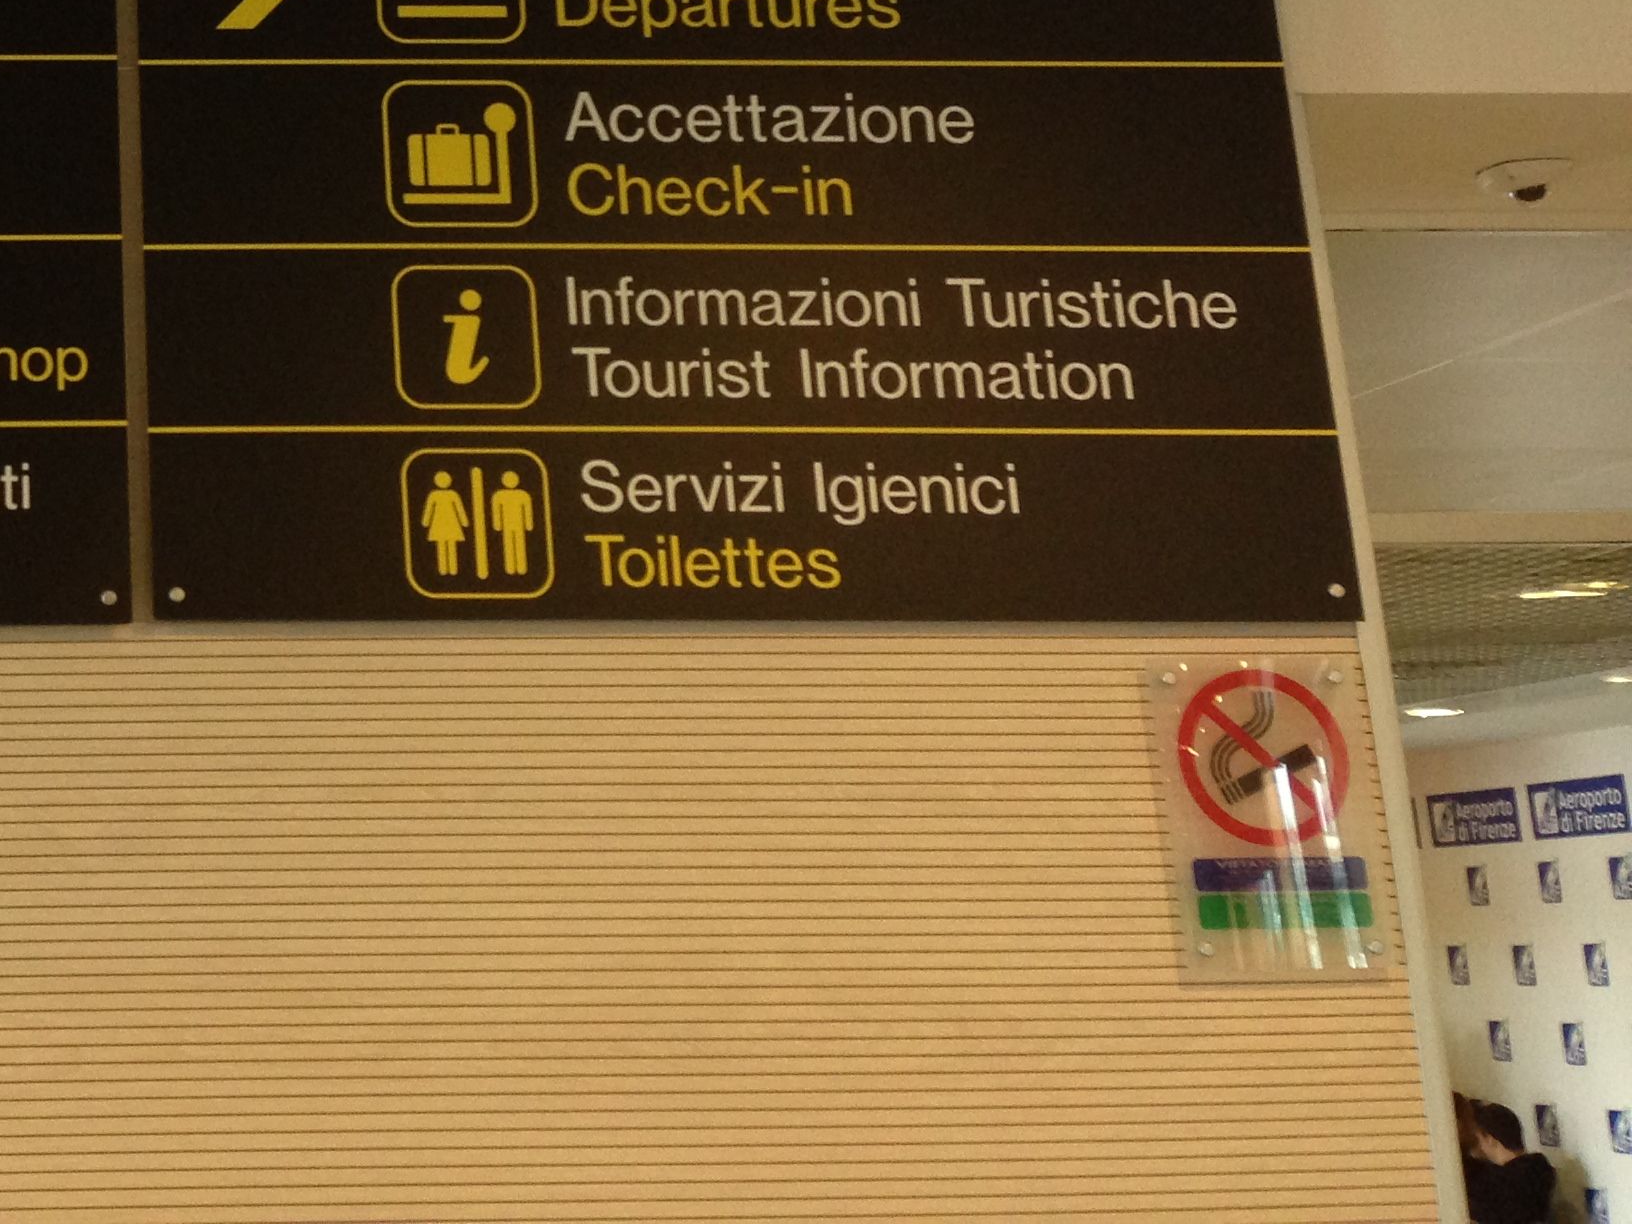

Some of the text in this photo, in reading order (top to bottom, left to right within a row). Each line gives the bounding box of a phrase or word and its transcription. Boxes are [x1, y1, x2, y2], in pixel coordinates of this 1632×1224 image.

[565, 91, 975, 145] Accettazione
[567, 162, 853, 217] Check-in
[565, 275, 1238, 330] Informazioni Turistiche
[570, 346, 1135, 401] Tourist Information
[580, 458, 1021, 526] Servizi Igienici
[583, 533, 842, 590] Toilettes
[1456, 800, 1514, 823] Aeroporto
[1559, 788, 1622, 812] Aeroporto
[1560, 811, 1626, 833] di Firenze
[1458, 821, 1516, 842] di Firenze
